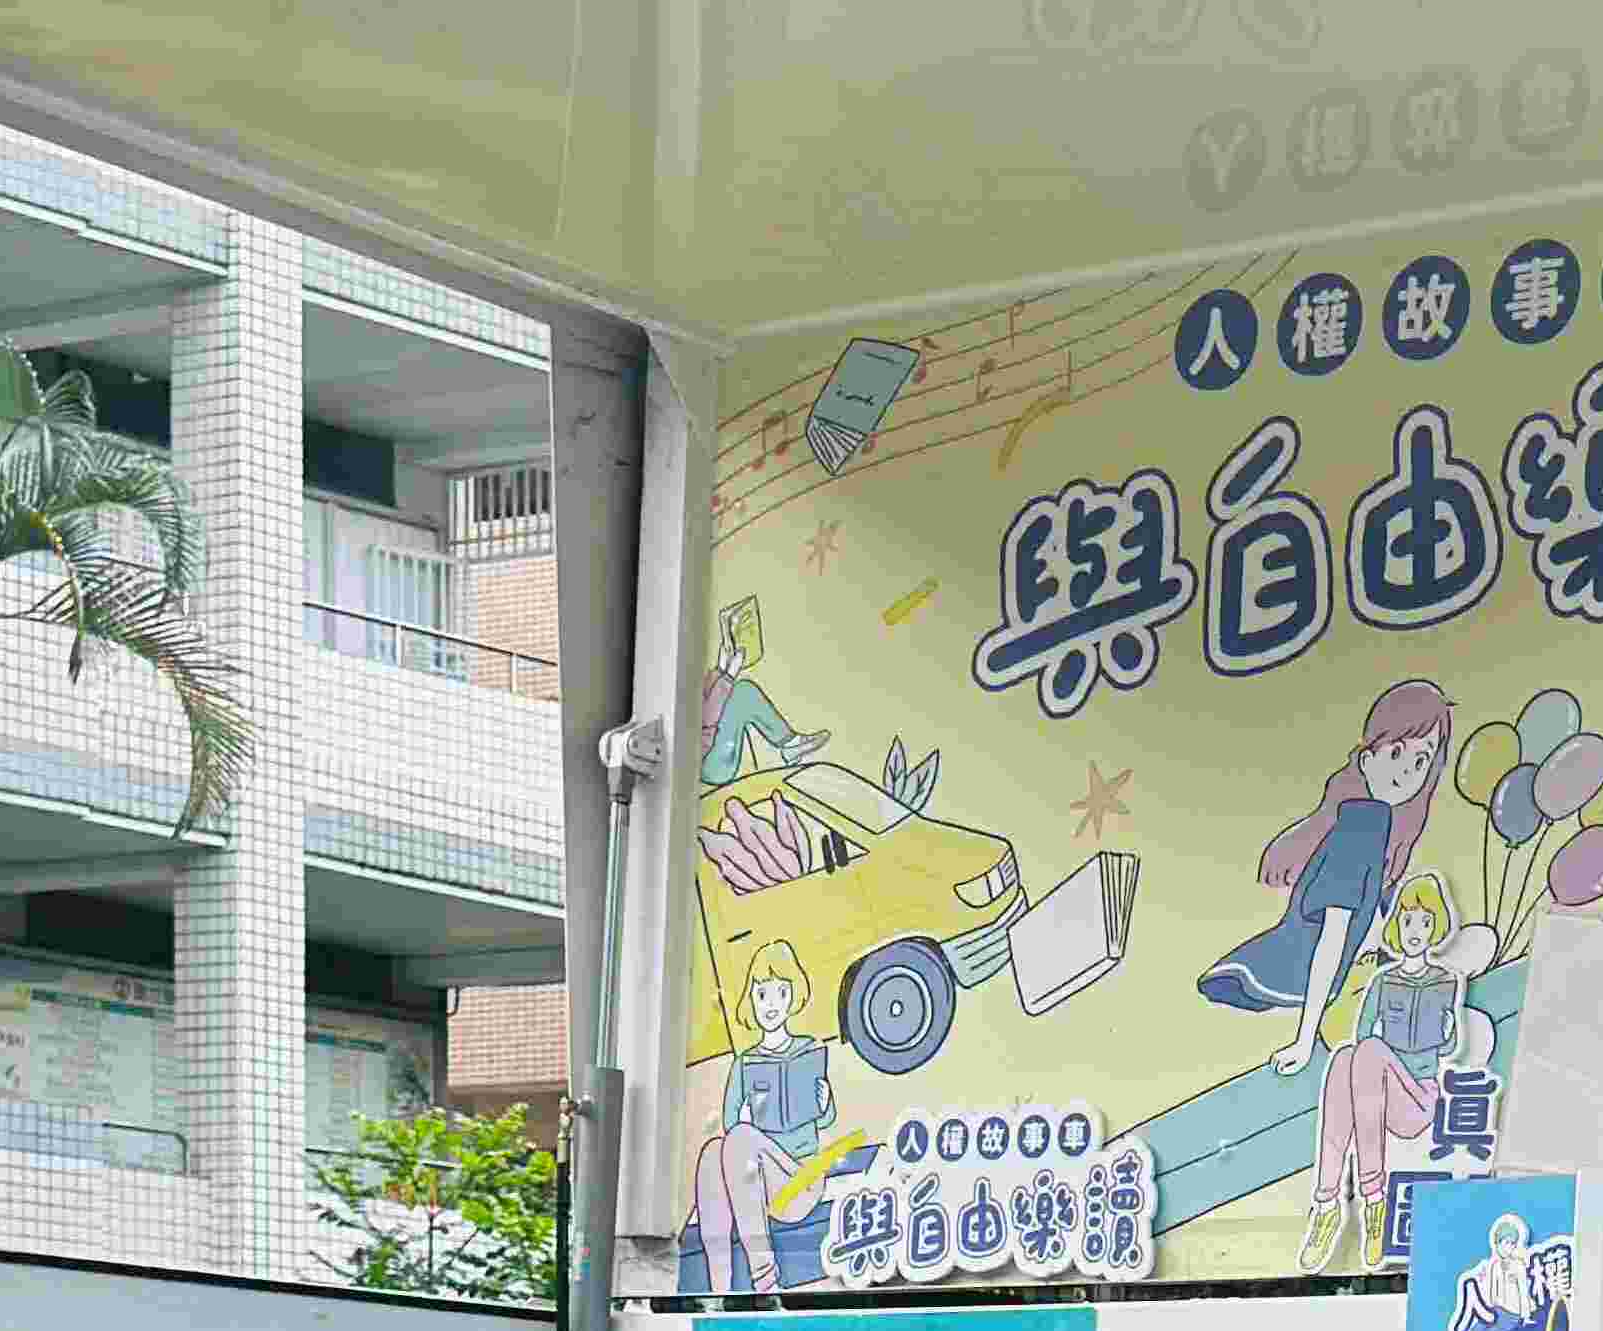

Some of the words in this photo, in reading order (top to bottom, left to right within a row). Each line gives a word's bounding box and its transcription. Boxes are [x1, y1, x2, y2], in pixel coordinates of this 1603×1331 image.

[897, 1113, 1091, 1163] 人權故事車
[829, 1150, 1144, 1277] 與自由樂讀
